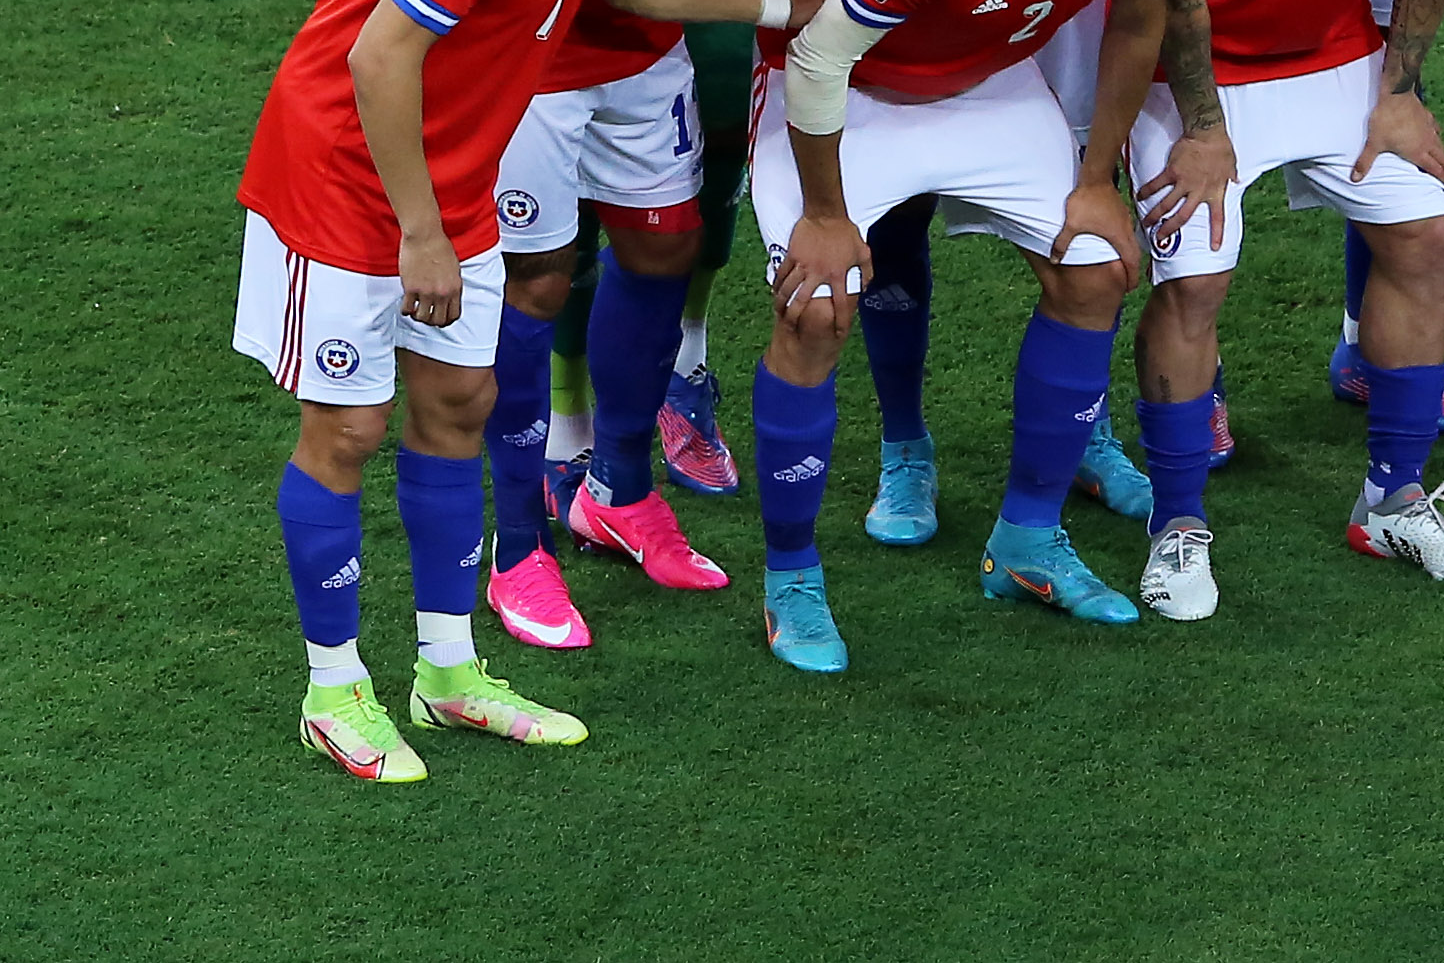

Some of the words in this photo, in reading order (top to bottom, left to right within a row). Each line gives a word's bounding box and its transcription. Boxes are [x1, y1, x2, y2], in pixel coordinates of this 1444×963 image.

[972, 2, 1009, 15] adidas
[1008, 0, 1054, 44] 2
[774, 461, 825, 482] adidas
